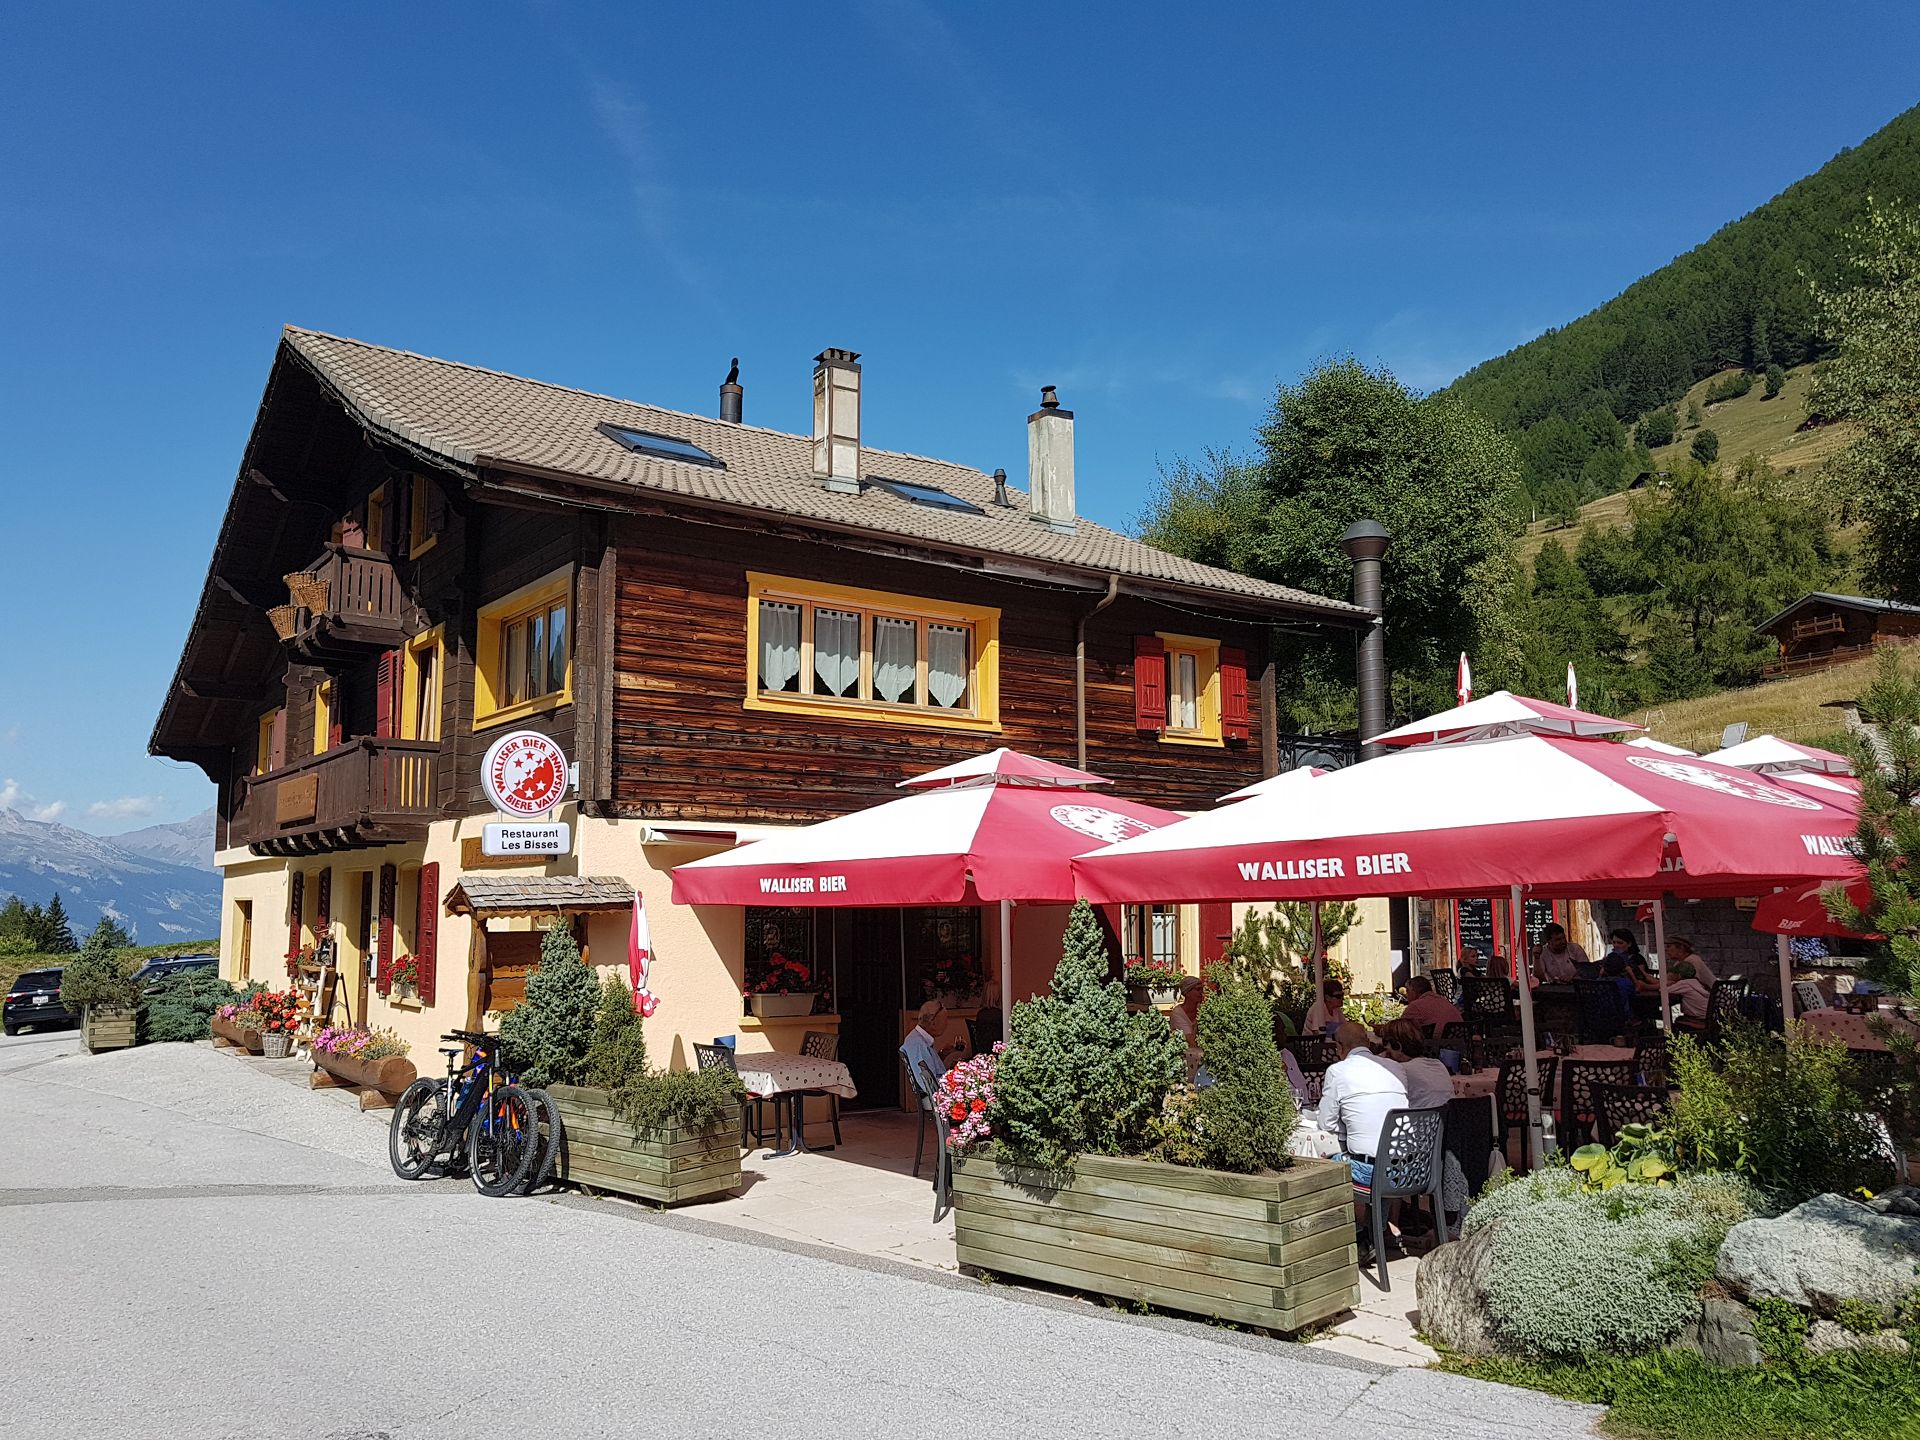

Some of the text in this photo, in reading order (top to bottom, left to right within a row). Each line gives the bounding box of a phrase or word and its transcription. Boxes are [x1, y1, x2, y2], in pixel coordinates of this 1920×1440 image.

[494, 738, 547, 793] WALLISER BIER
[505, 750, 563, 811] BIERE VALAISANNE
[501, 829, 559, 839] Restaurant
[501, 840, 559, 850] Les Bisses
[1237, 852, 1412, 881] WALLISER BIER
[759, 875, 847, 893] WALLISER BIER
